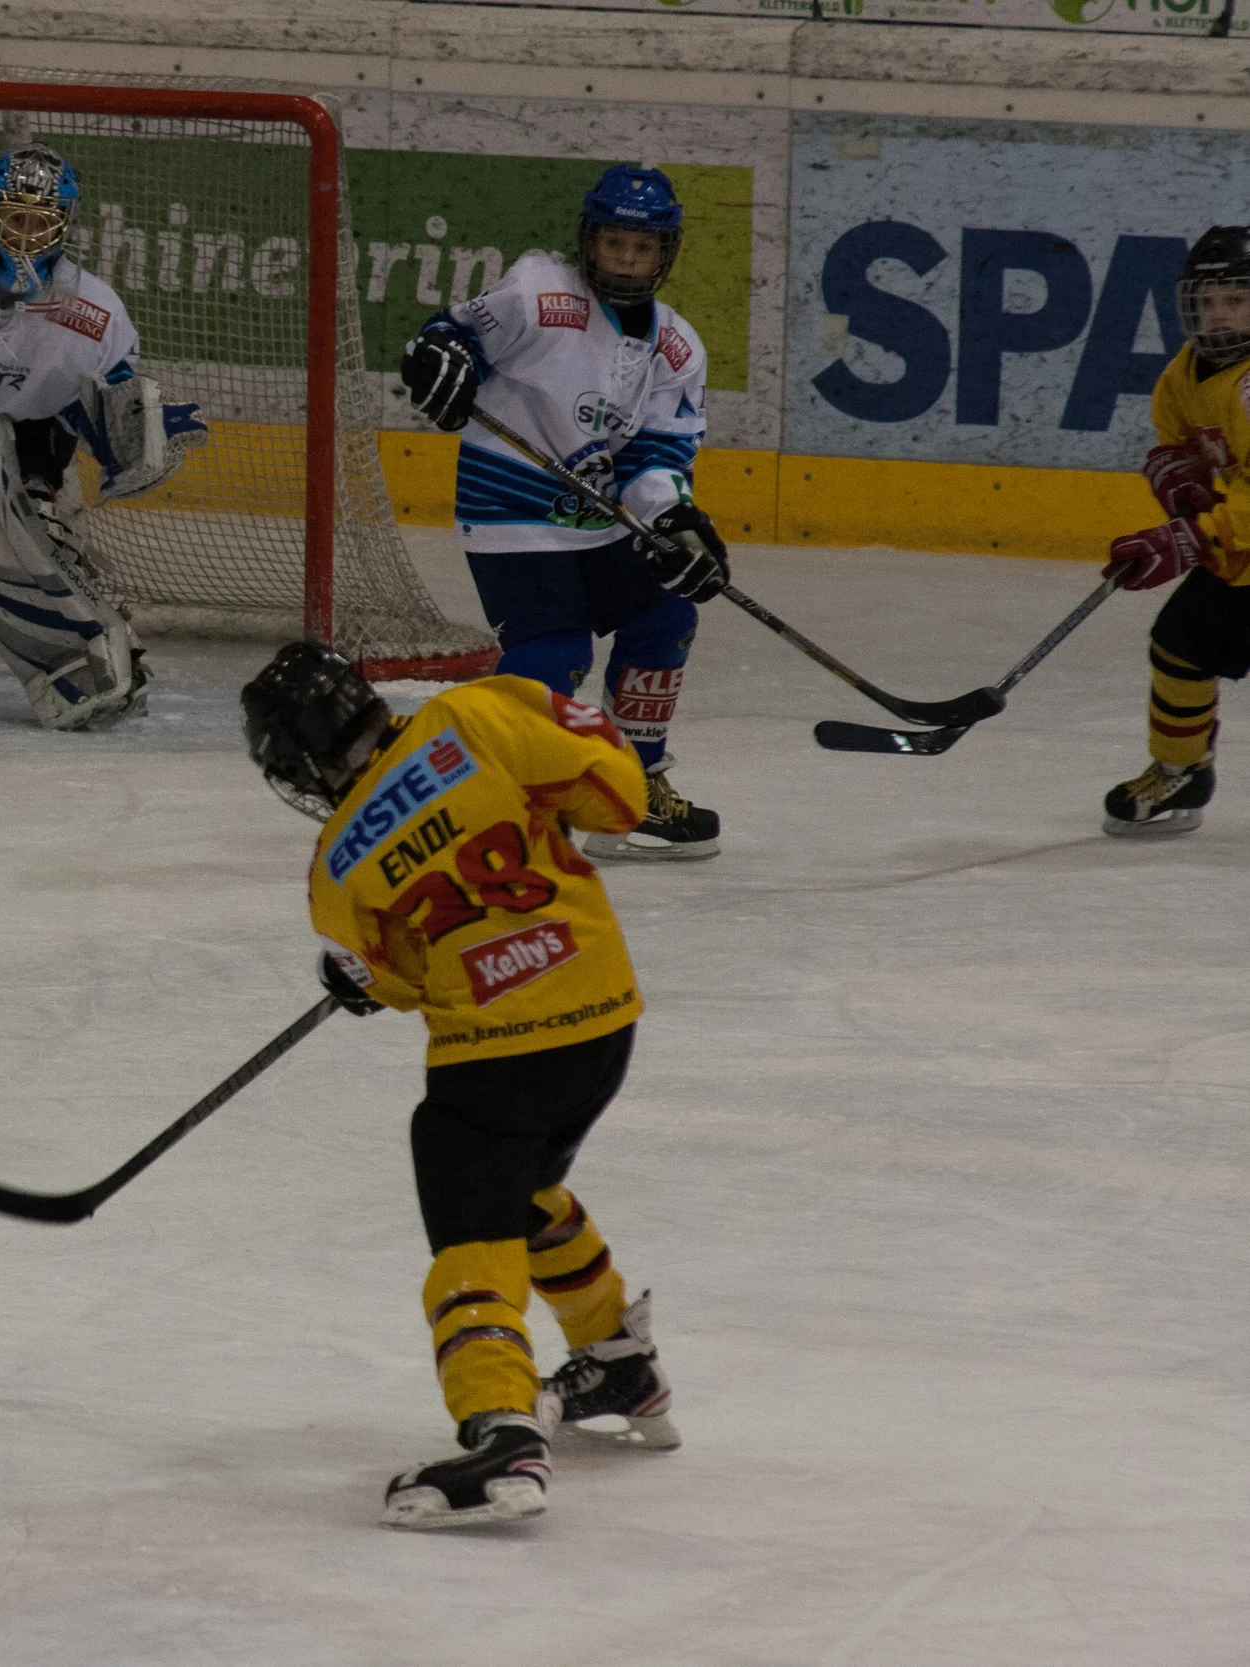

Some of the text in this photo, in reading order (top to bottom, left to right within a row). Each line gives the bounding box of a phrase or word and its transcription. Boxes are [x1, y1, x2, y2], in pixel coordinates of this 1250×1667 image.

[541, 295, 589, 313] KLEINE
[330, 763, 439, 881] ERSTE
[379, 807, 466, 888] ENDL
[475, 930, 565, 987] Kelly's
